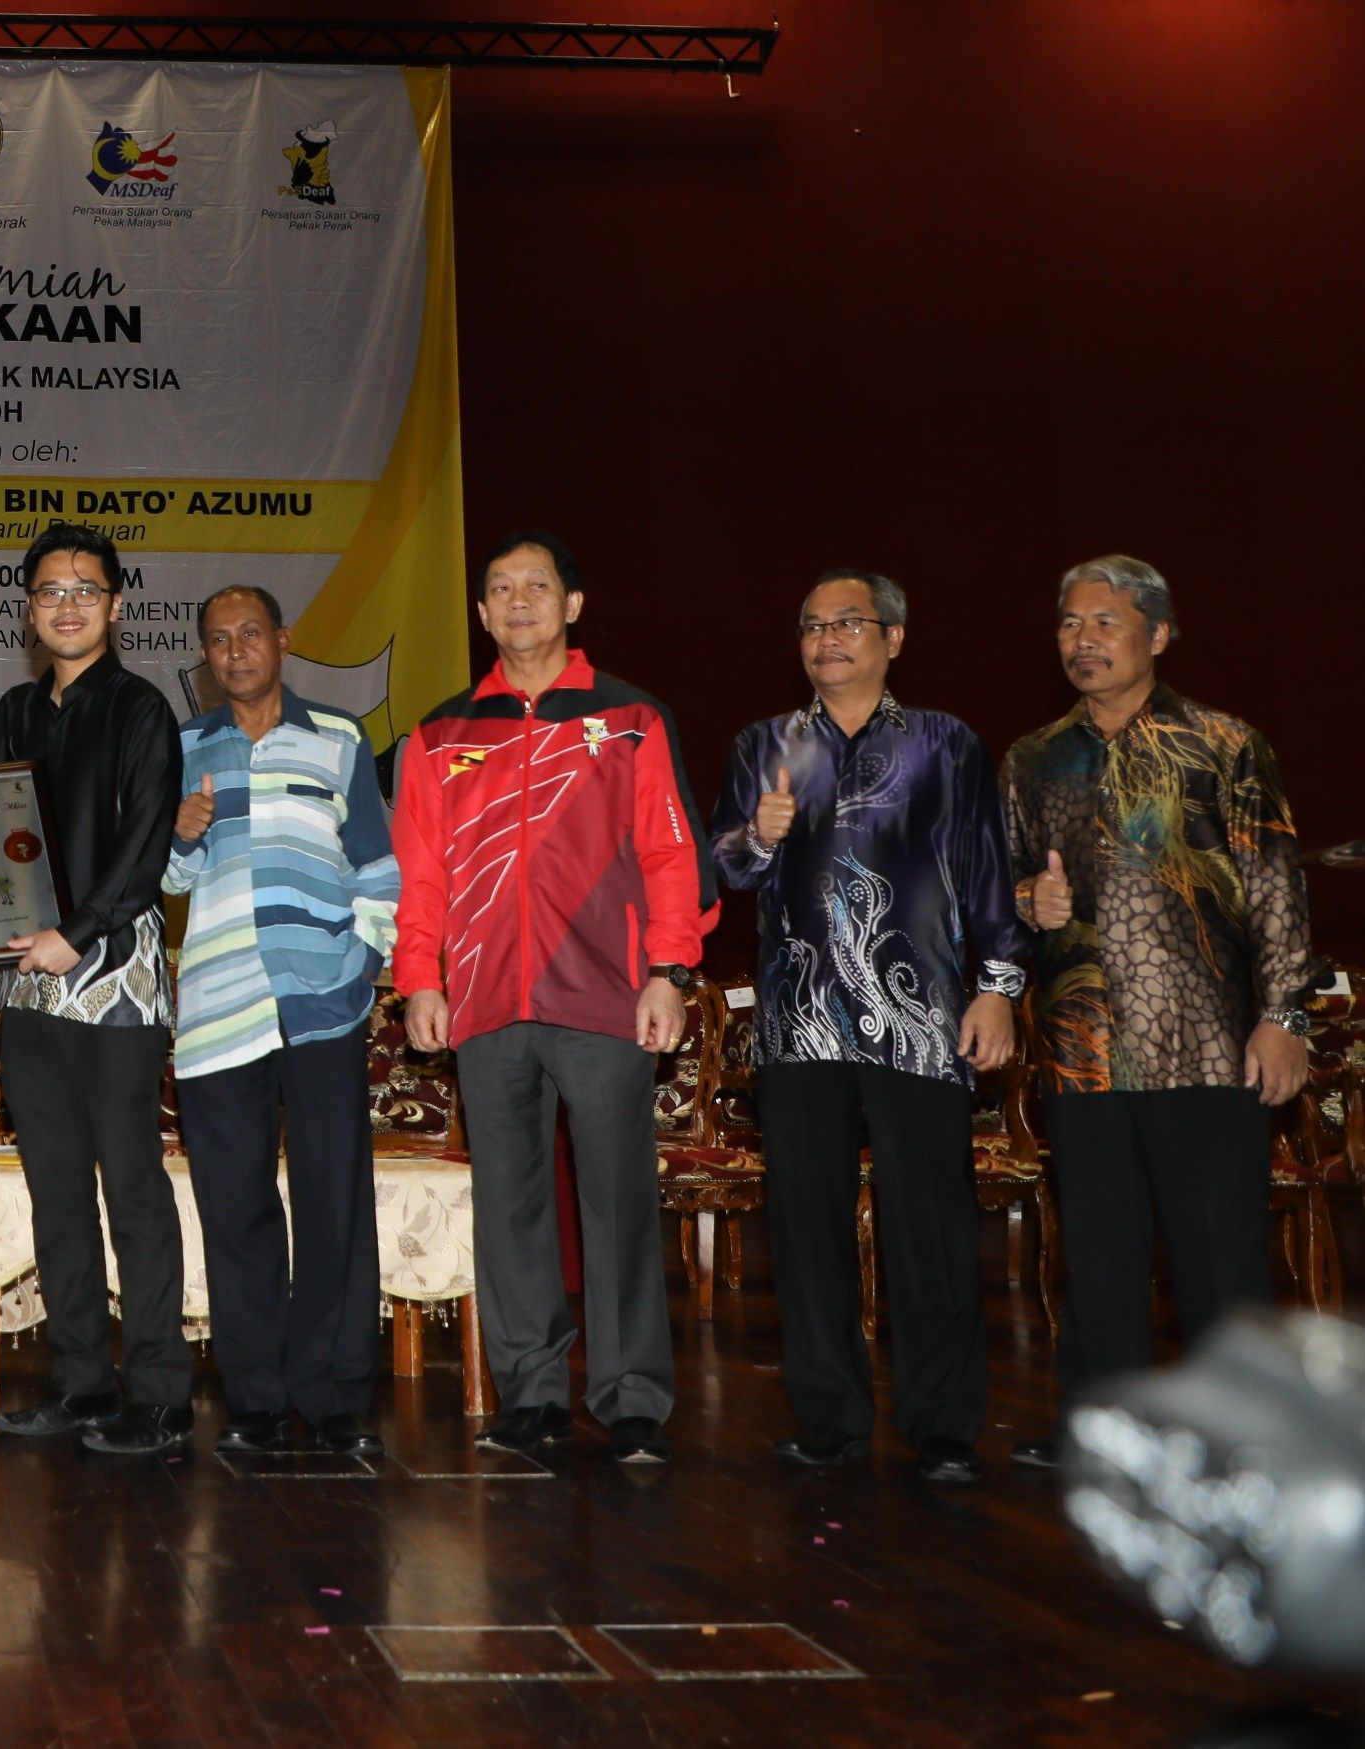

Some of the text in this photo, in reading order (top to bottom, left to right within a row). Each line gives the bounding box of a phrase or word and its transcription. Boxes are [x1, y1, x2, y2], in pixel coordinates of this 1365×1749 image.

[108, 183, 179, 201] MSDeaf
[72, 205, 193, 219] Persatuan Sukan Orang
[260, 209, 380, 223] Persatuan Sukan Orang
[93, 216, 172, 229] Pekak Malaysia
[289, 220, 354, 232] Pekak Perak
[31, 365, 181, 390] MALAYSIA
[12, 439, 79, 463] oleh:
[3, 488, 64, 514] BIN
[76, 490, 176, 515] DATO'
[186, 491, 313, 517] AZUMU
[119, 631, 194, 651] SHAH.
